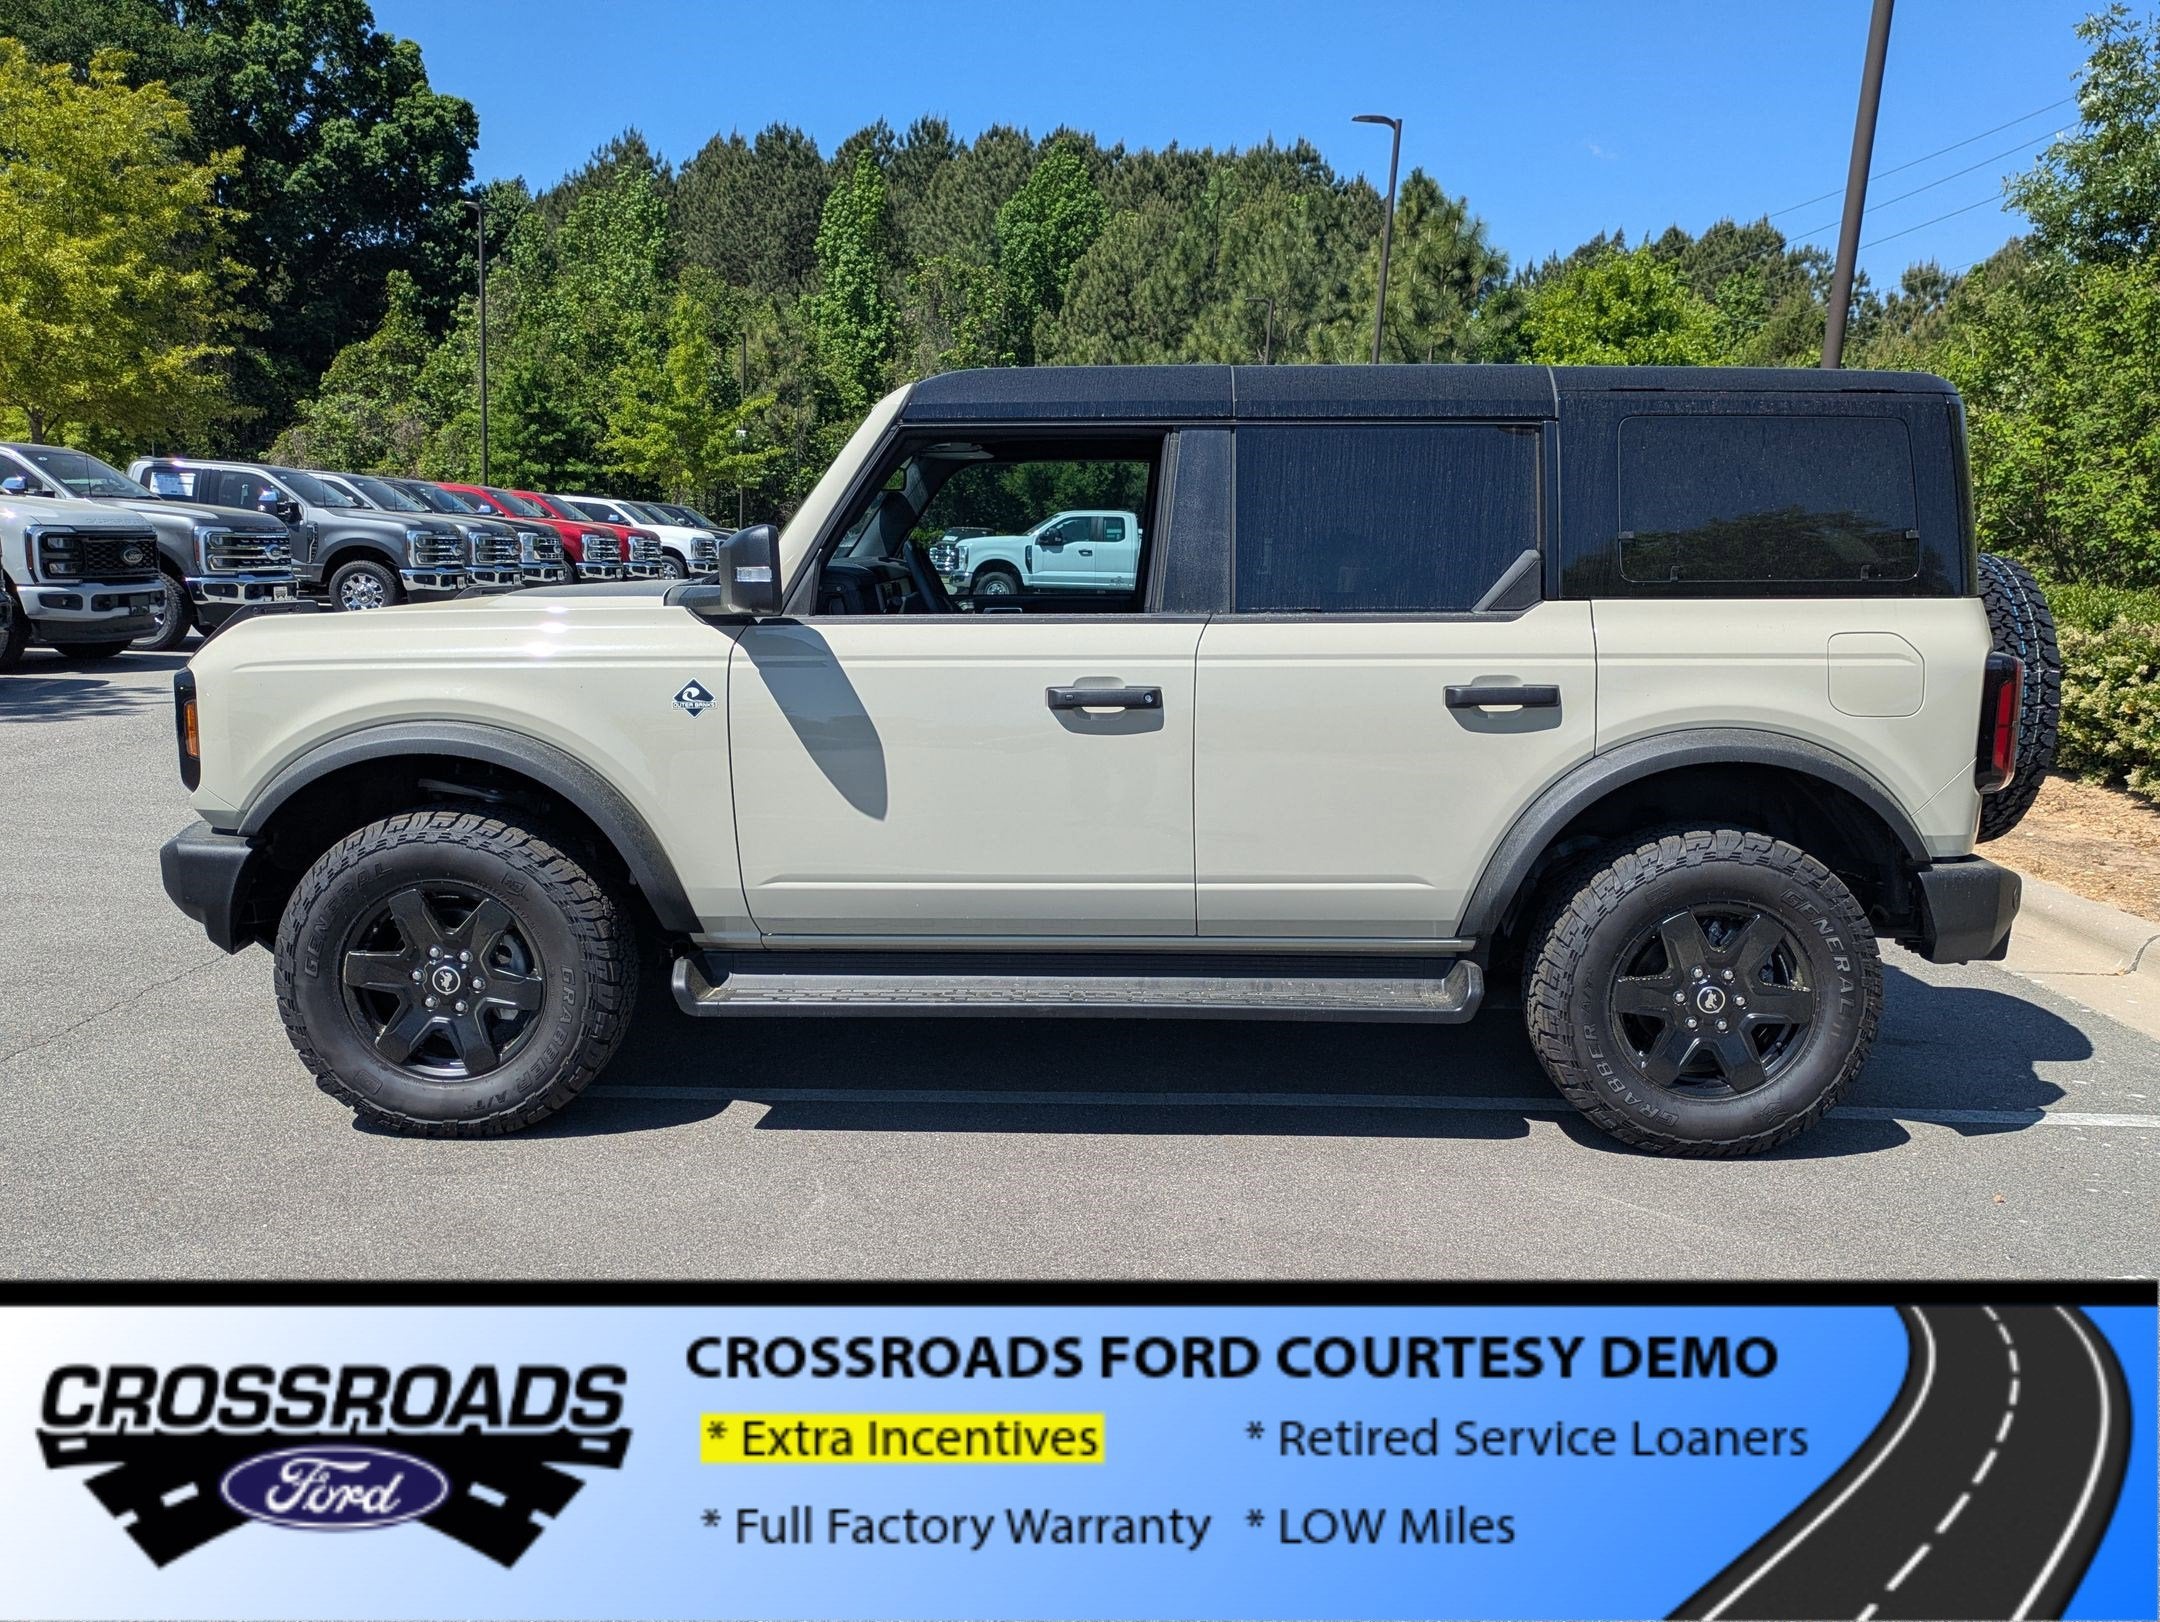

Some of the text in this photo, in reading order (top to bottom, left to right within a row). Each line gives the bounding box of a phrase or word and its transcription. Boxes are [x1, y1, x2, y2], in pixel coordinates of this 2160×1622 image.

[303, 861, 394, 978] GENERAL
[1781, 889, 1856, 1016] GENERAL
[513, 964, 577, 1094] GRABBER
[1583, 1023, 1680, 1128] GRABBER
